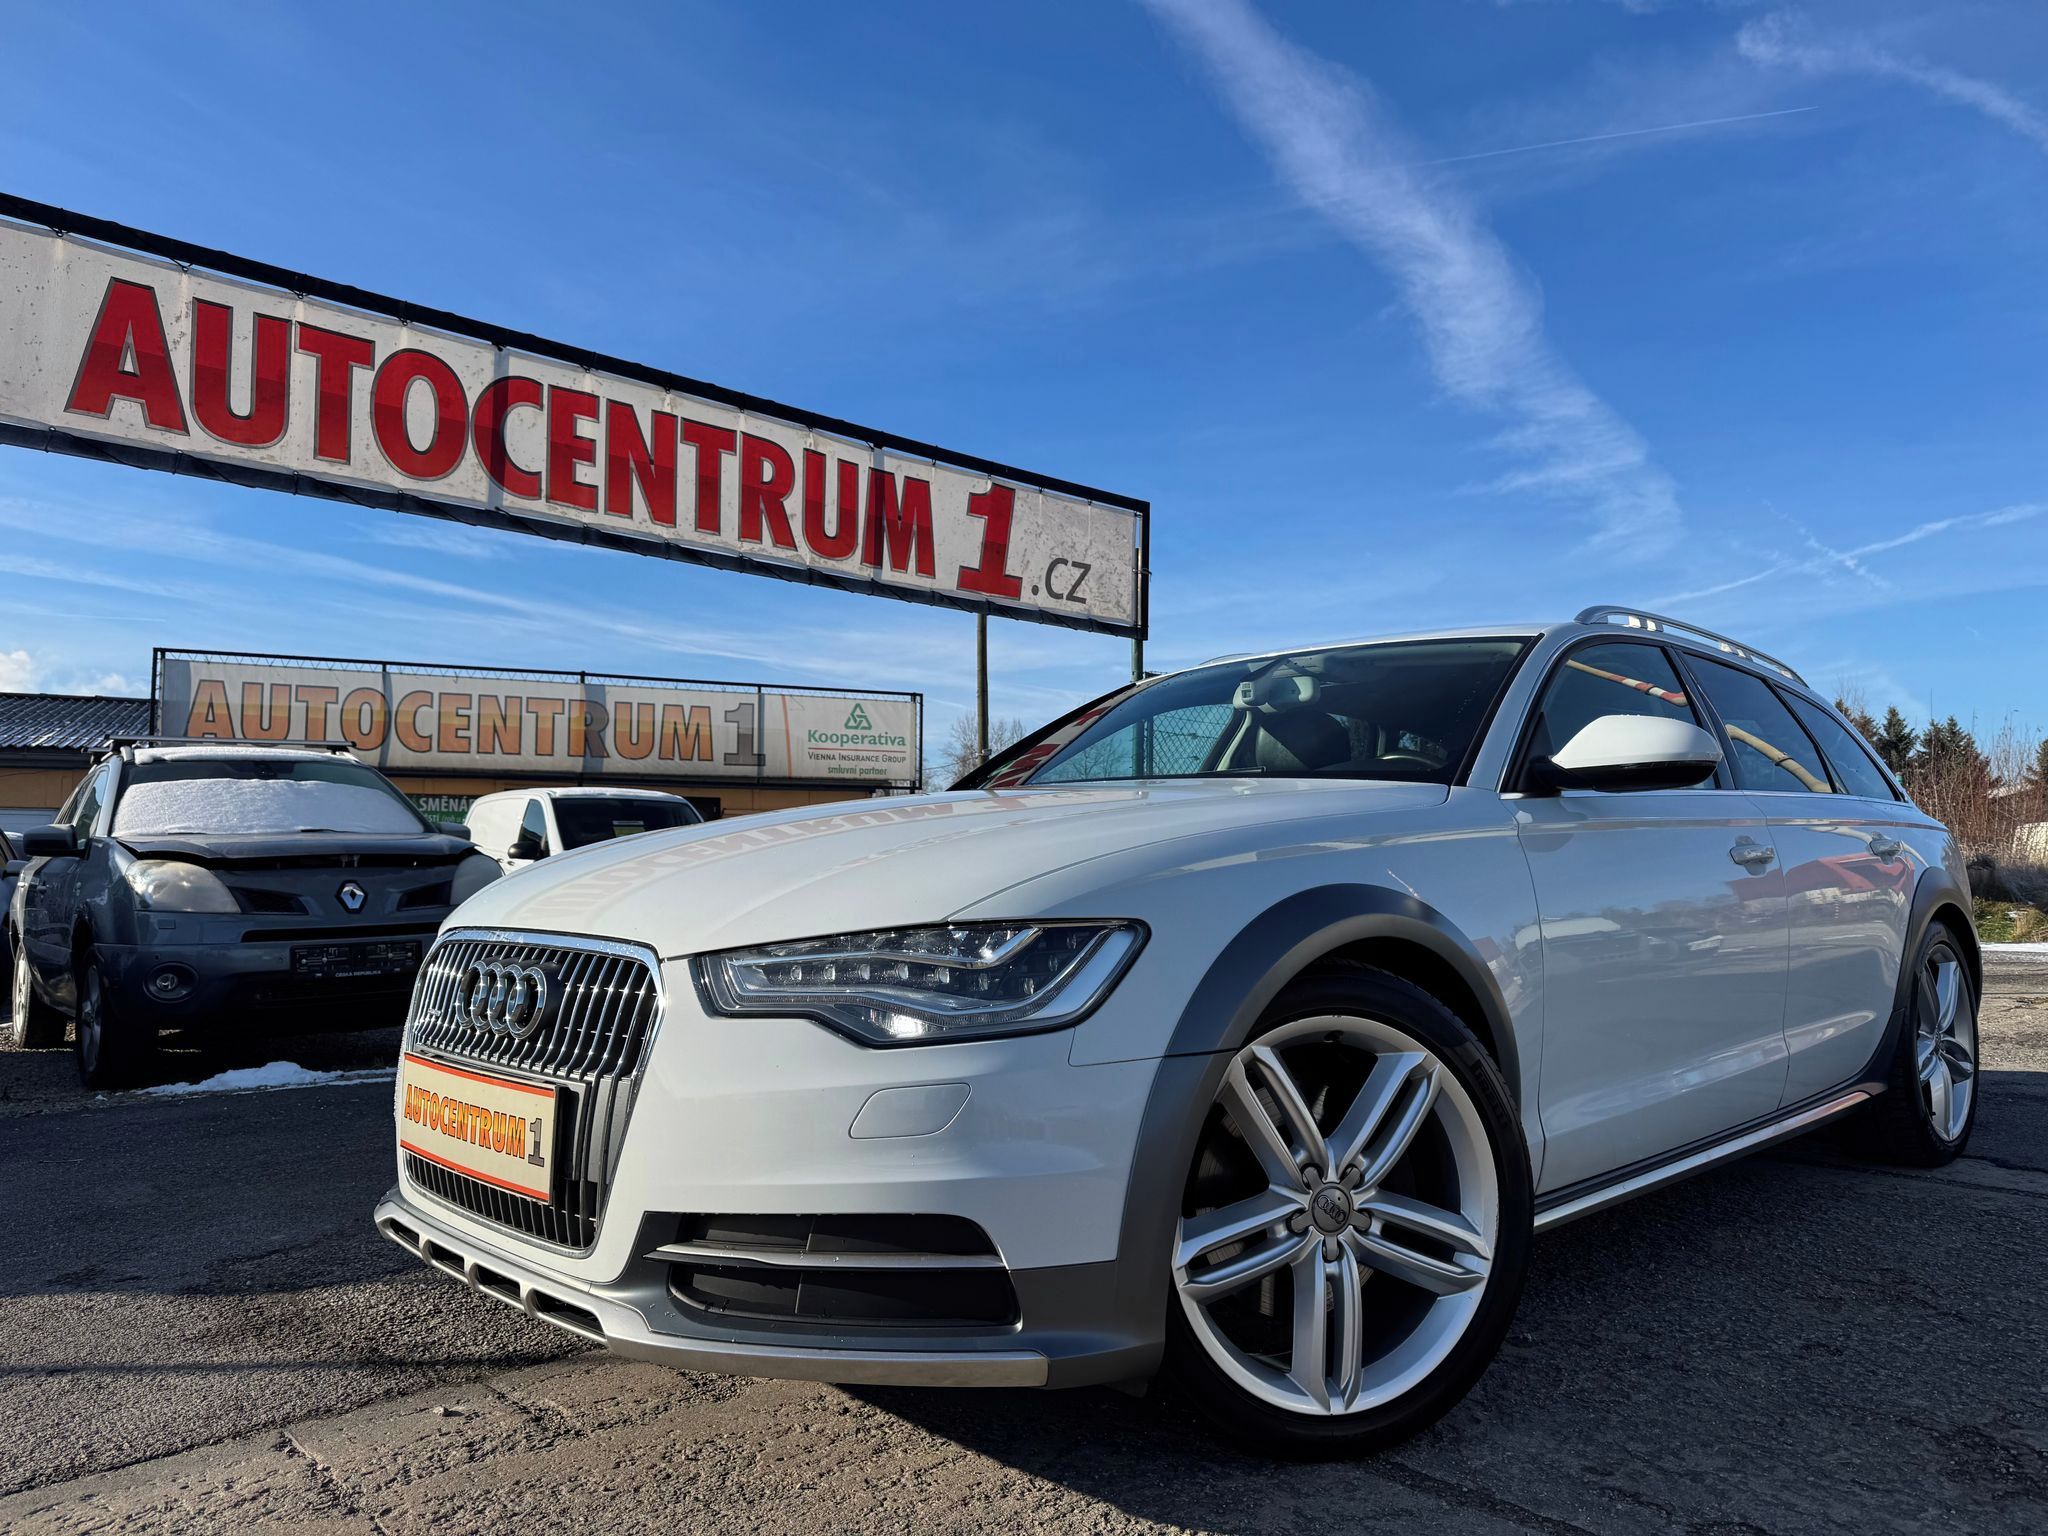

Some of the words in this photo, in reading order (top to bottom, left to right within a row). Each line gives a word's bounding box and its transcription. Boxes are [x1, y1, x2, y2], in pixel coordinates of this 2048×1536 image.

[64, 276, 936, 579] AUTOCENTRUM
[956, 482, 1023, 601] 1
[185, 679, 714, 762] AUTOCENTRUM
[723, 702, 766, 767] 1
[807, 729, 907, 748] Kooperativa
[808, 751, 836, 761] VIENNA
[838, 752, 880, 763] INSURANCE
[881, 754, 907, 764] GROUP
[859, 766, 887, 777] partner
[404, 1083, 526, 1160] AUTOCENTRUM
[527, 1117, 545, 1168] 1
